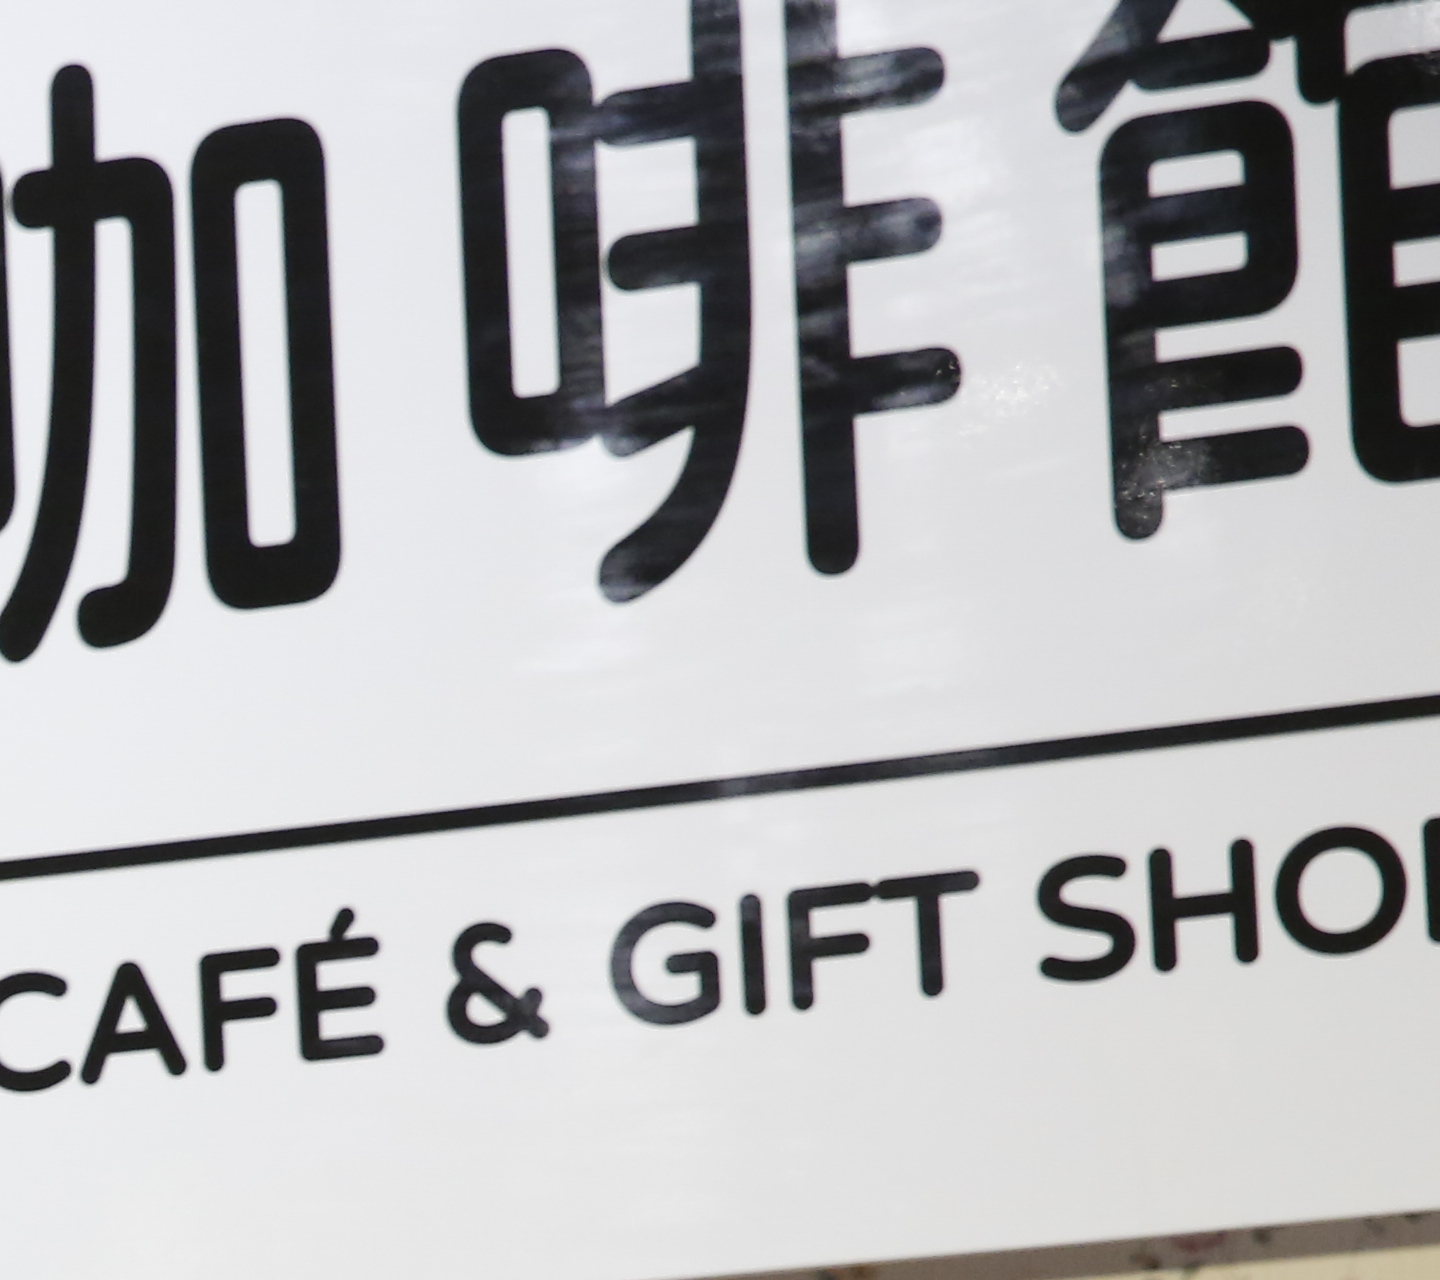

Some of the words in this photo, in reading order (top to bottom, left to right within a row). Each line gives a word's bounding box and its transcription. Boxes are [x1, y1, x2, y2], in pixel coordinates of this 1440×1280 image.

[445, 921, 550, 1046] &
[610, 869, 981, 1026] GIFT
[1036, 816, 1440, 984] SHO
